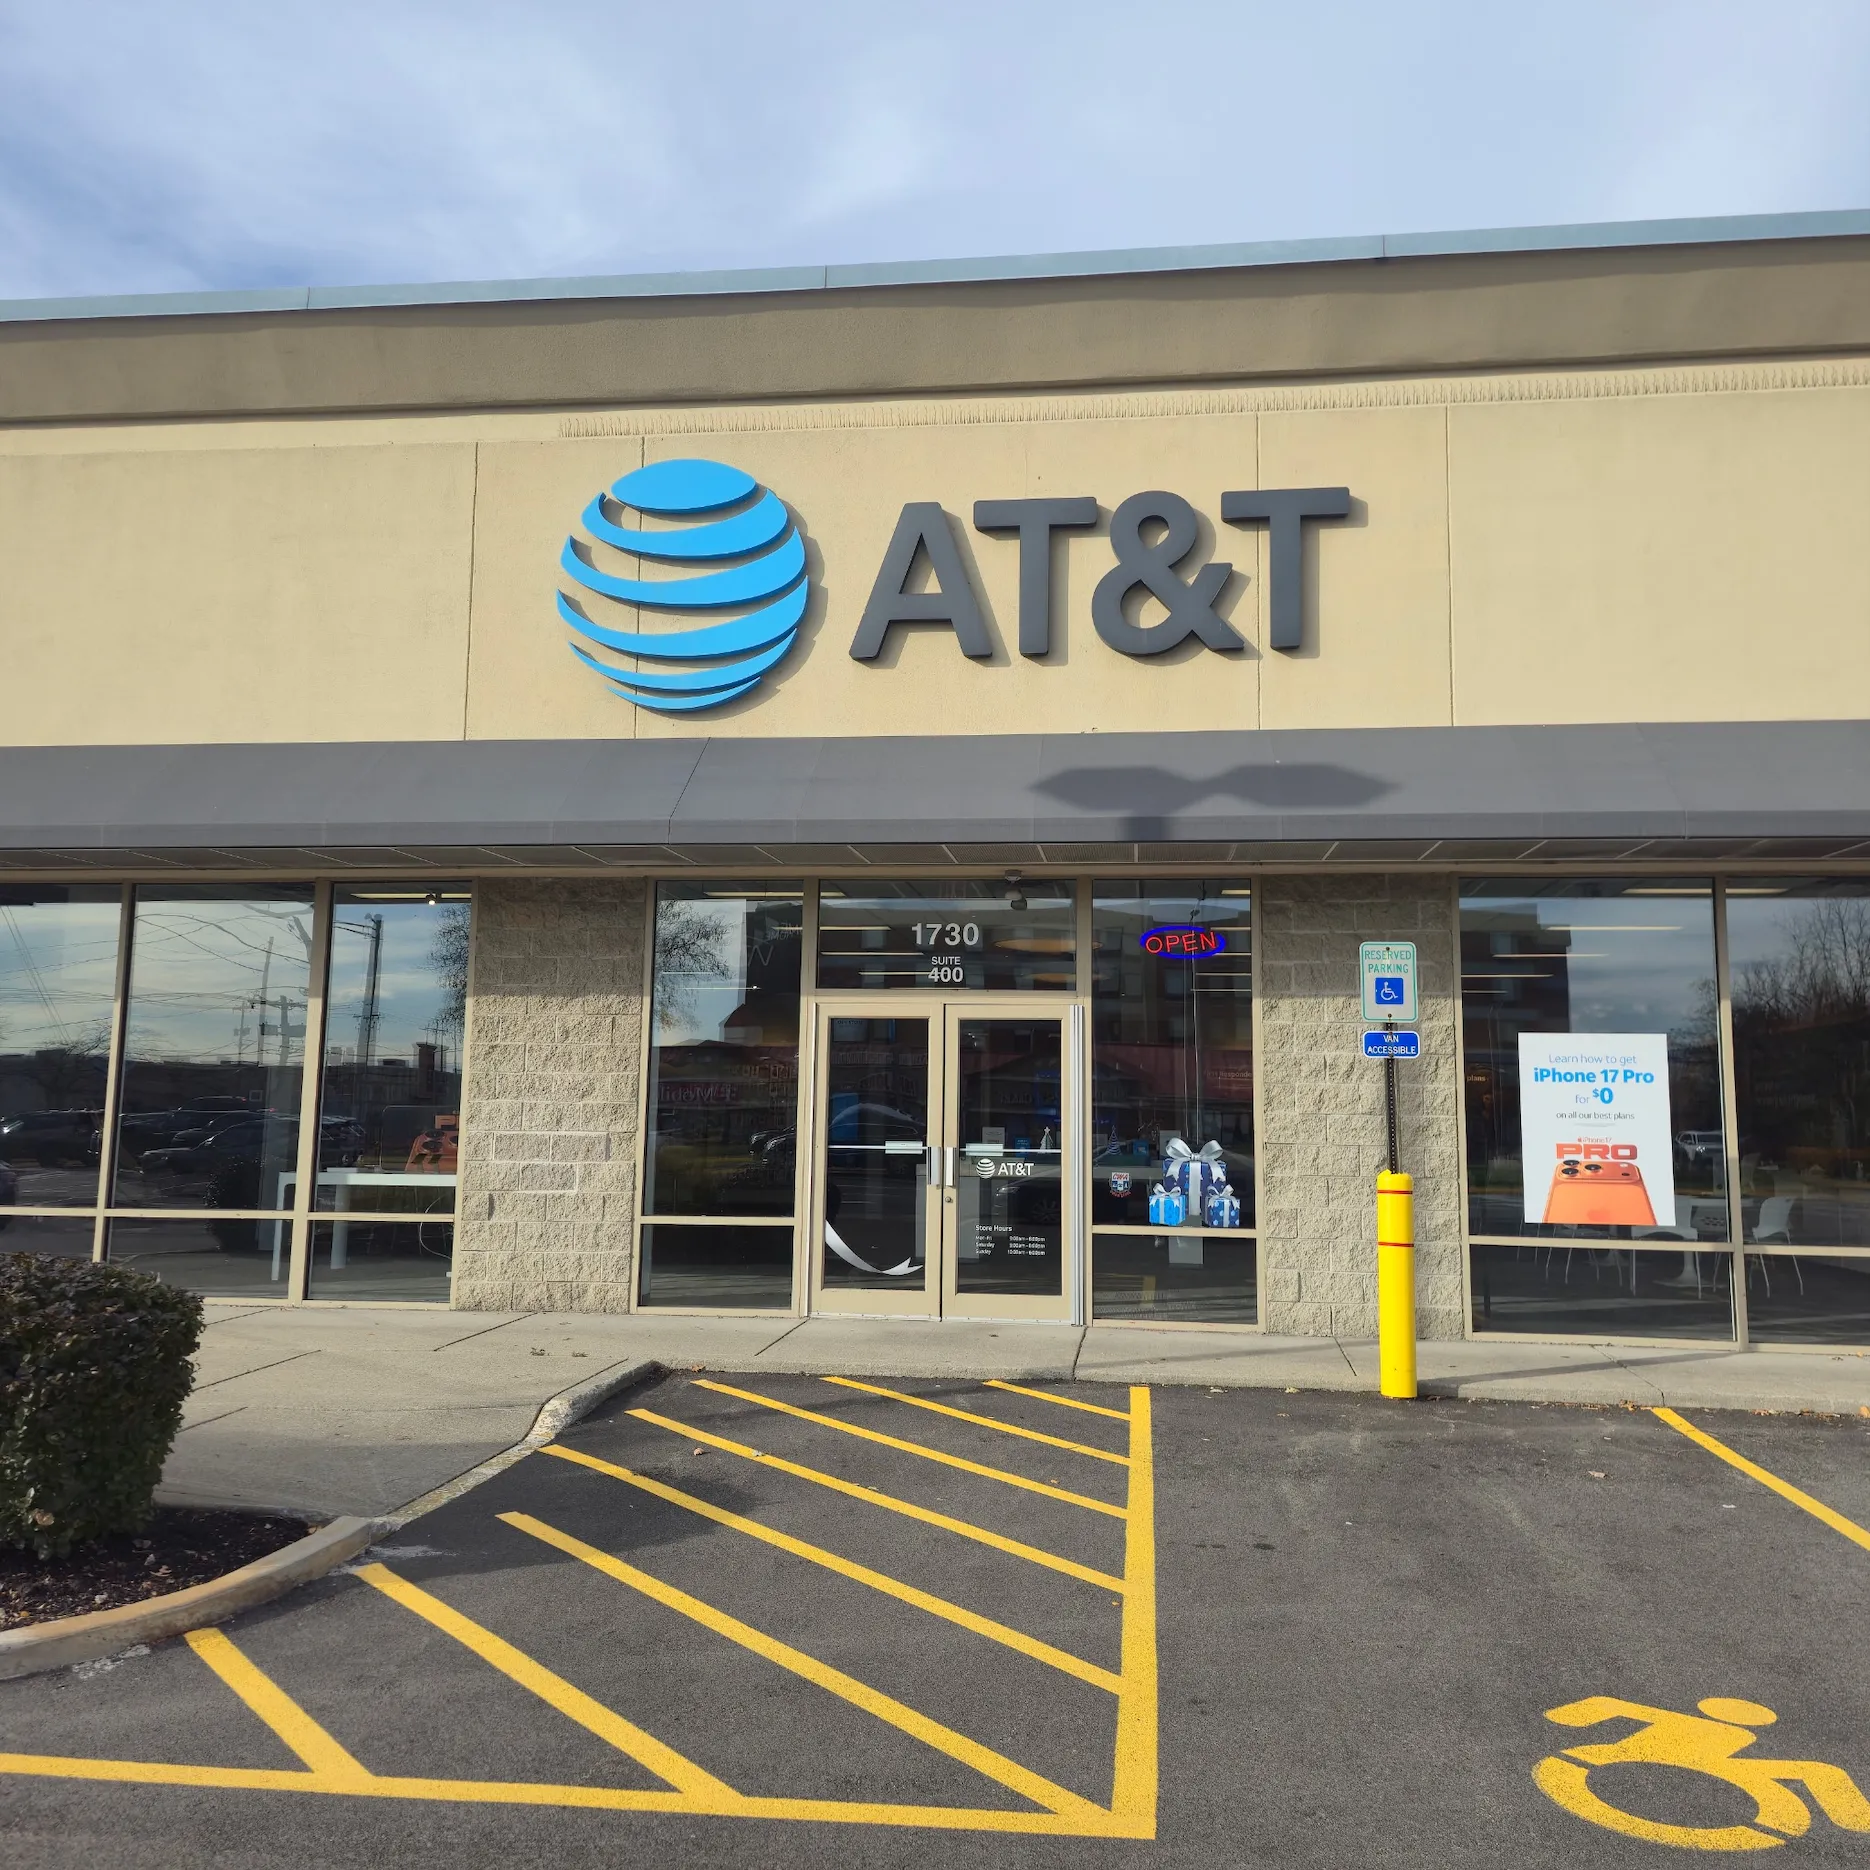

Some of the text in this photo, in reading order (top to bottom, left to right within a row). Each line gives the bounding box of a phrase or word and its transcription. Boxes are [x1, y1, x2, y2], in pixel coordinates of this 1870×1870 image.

[848, 487, 1351, 661] AT&T
[911, 922, 979, 946] 1730
[1145, 931, 1217, 954] OPEN
[931, 956, 961, 965] SUITE
[1364, 950, 1412, 960] RESERVED
[928, 967, 964, 982] 400
[1368, 963, 1409, 973] PARKING
[1383, 1034, 1399, 1043] VAN
[1367, 1045, 1416, 1054] ACCESSIBLE
[1548, 1054, 1637, 1066] Learn how to get
[1533, 1067, 1655, 1084] iPhone 17 Pro
[1575, 1087, 1614, 1104] for $0
[1568, 1111, 1577, 1119] all
[1593, 1112, 1612, 1120] best
[1613, 1112, 1635, 1121] plans
[1555, 1143, 1638, 1161] PRO
[997, 1162, 1035, 1176] AT&T
